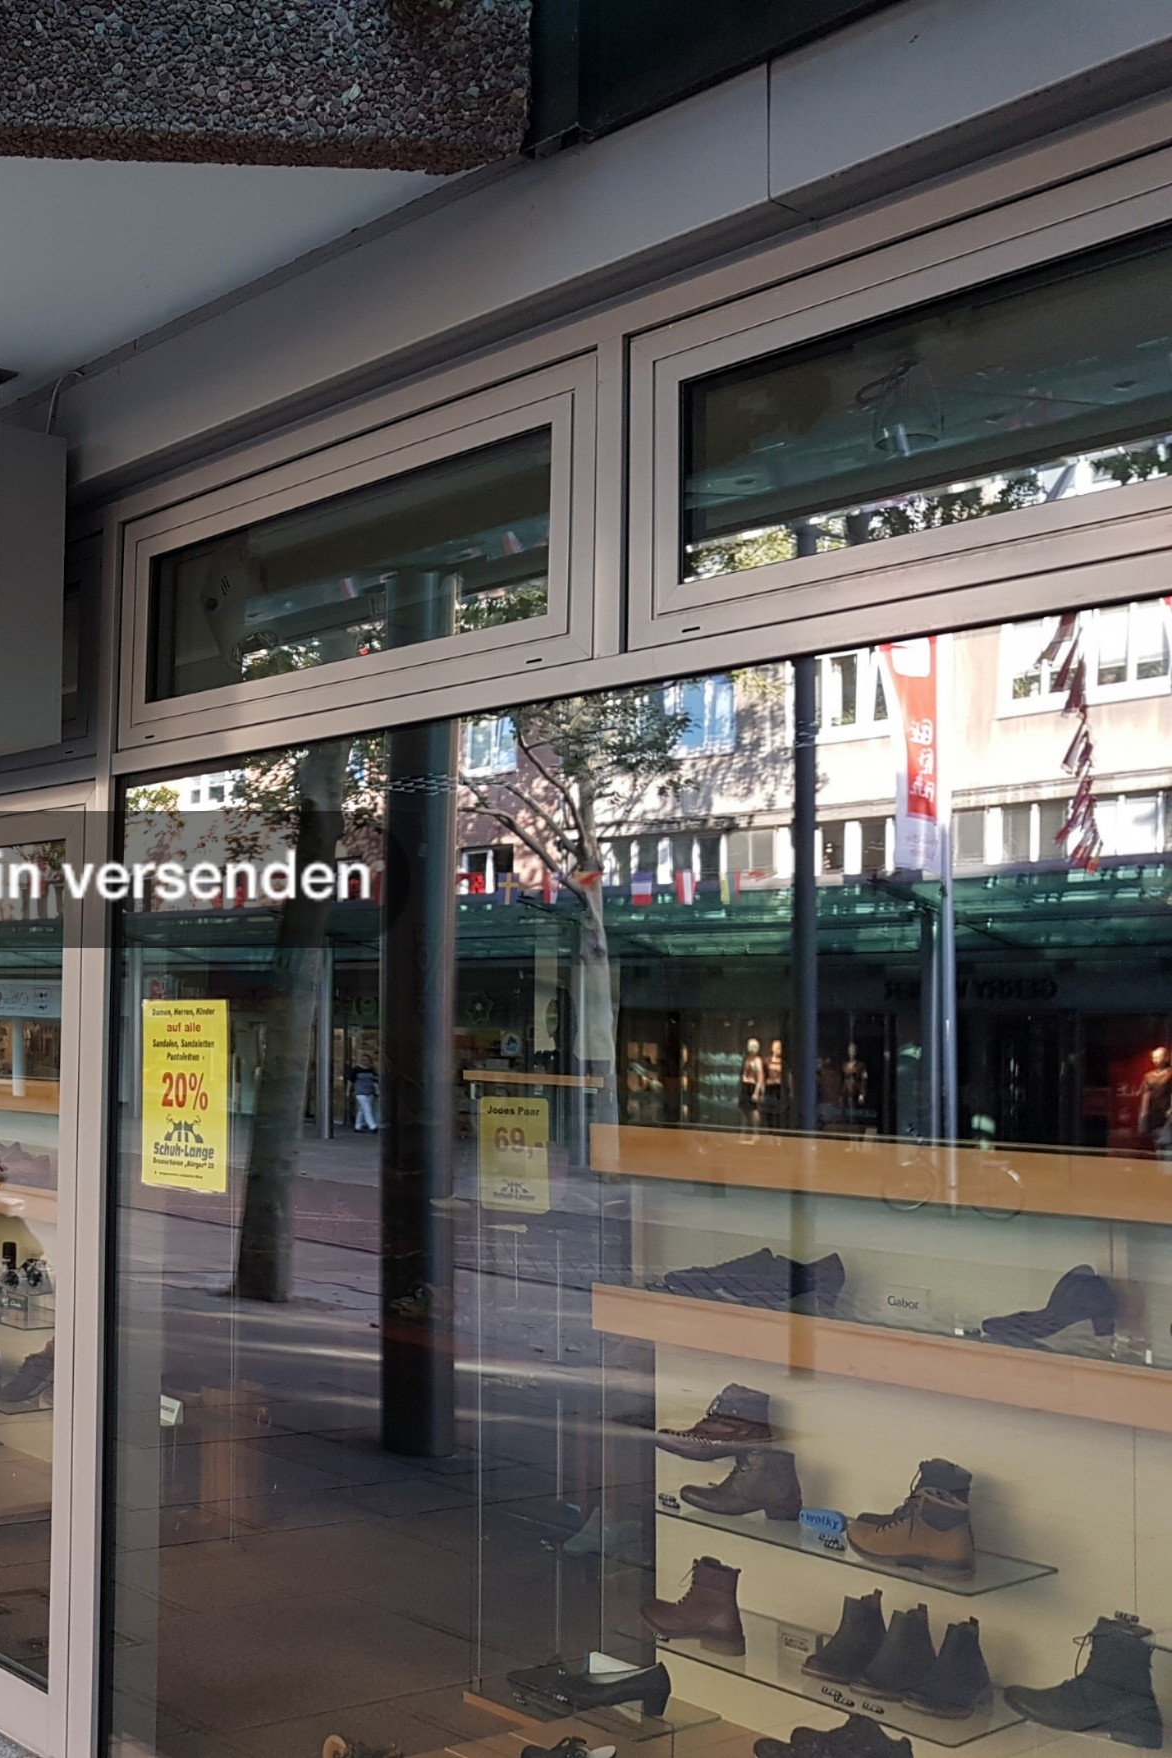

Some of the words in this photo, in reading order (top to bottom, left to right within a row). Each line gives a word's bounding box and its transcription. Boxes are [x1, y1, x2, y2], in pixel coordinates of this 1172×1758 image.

[166, 1022, 182, 1033] auf
[184, 1022, 202, 1033] alle
[161, 1071, 209, 1111] 20%
[517, 1106, 541, 1117] Paar
[153, 1141, 215, 1161] Schuh-Lange
[887, 1295, 920, 1310] Gabor
[804, 1511, 840, 1531] wolky
